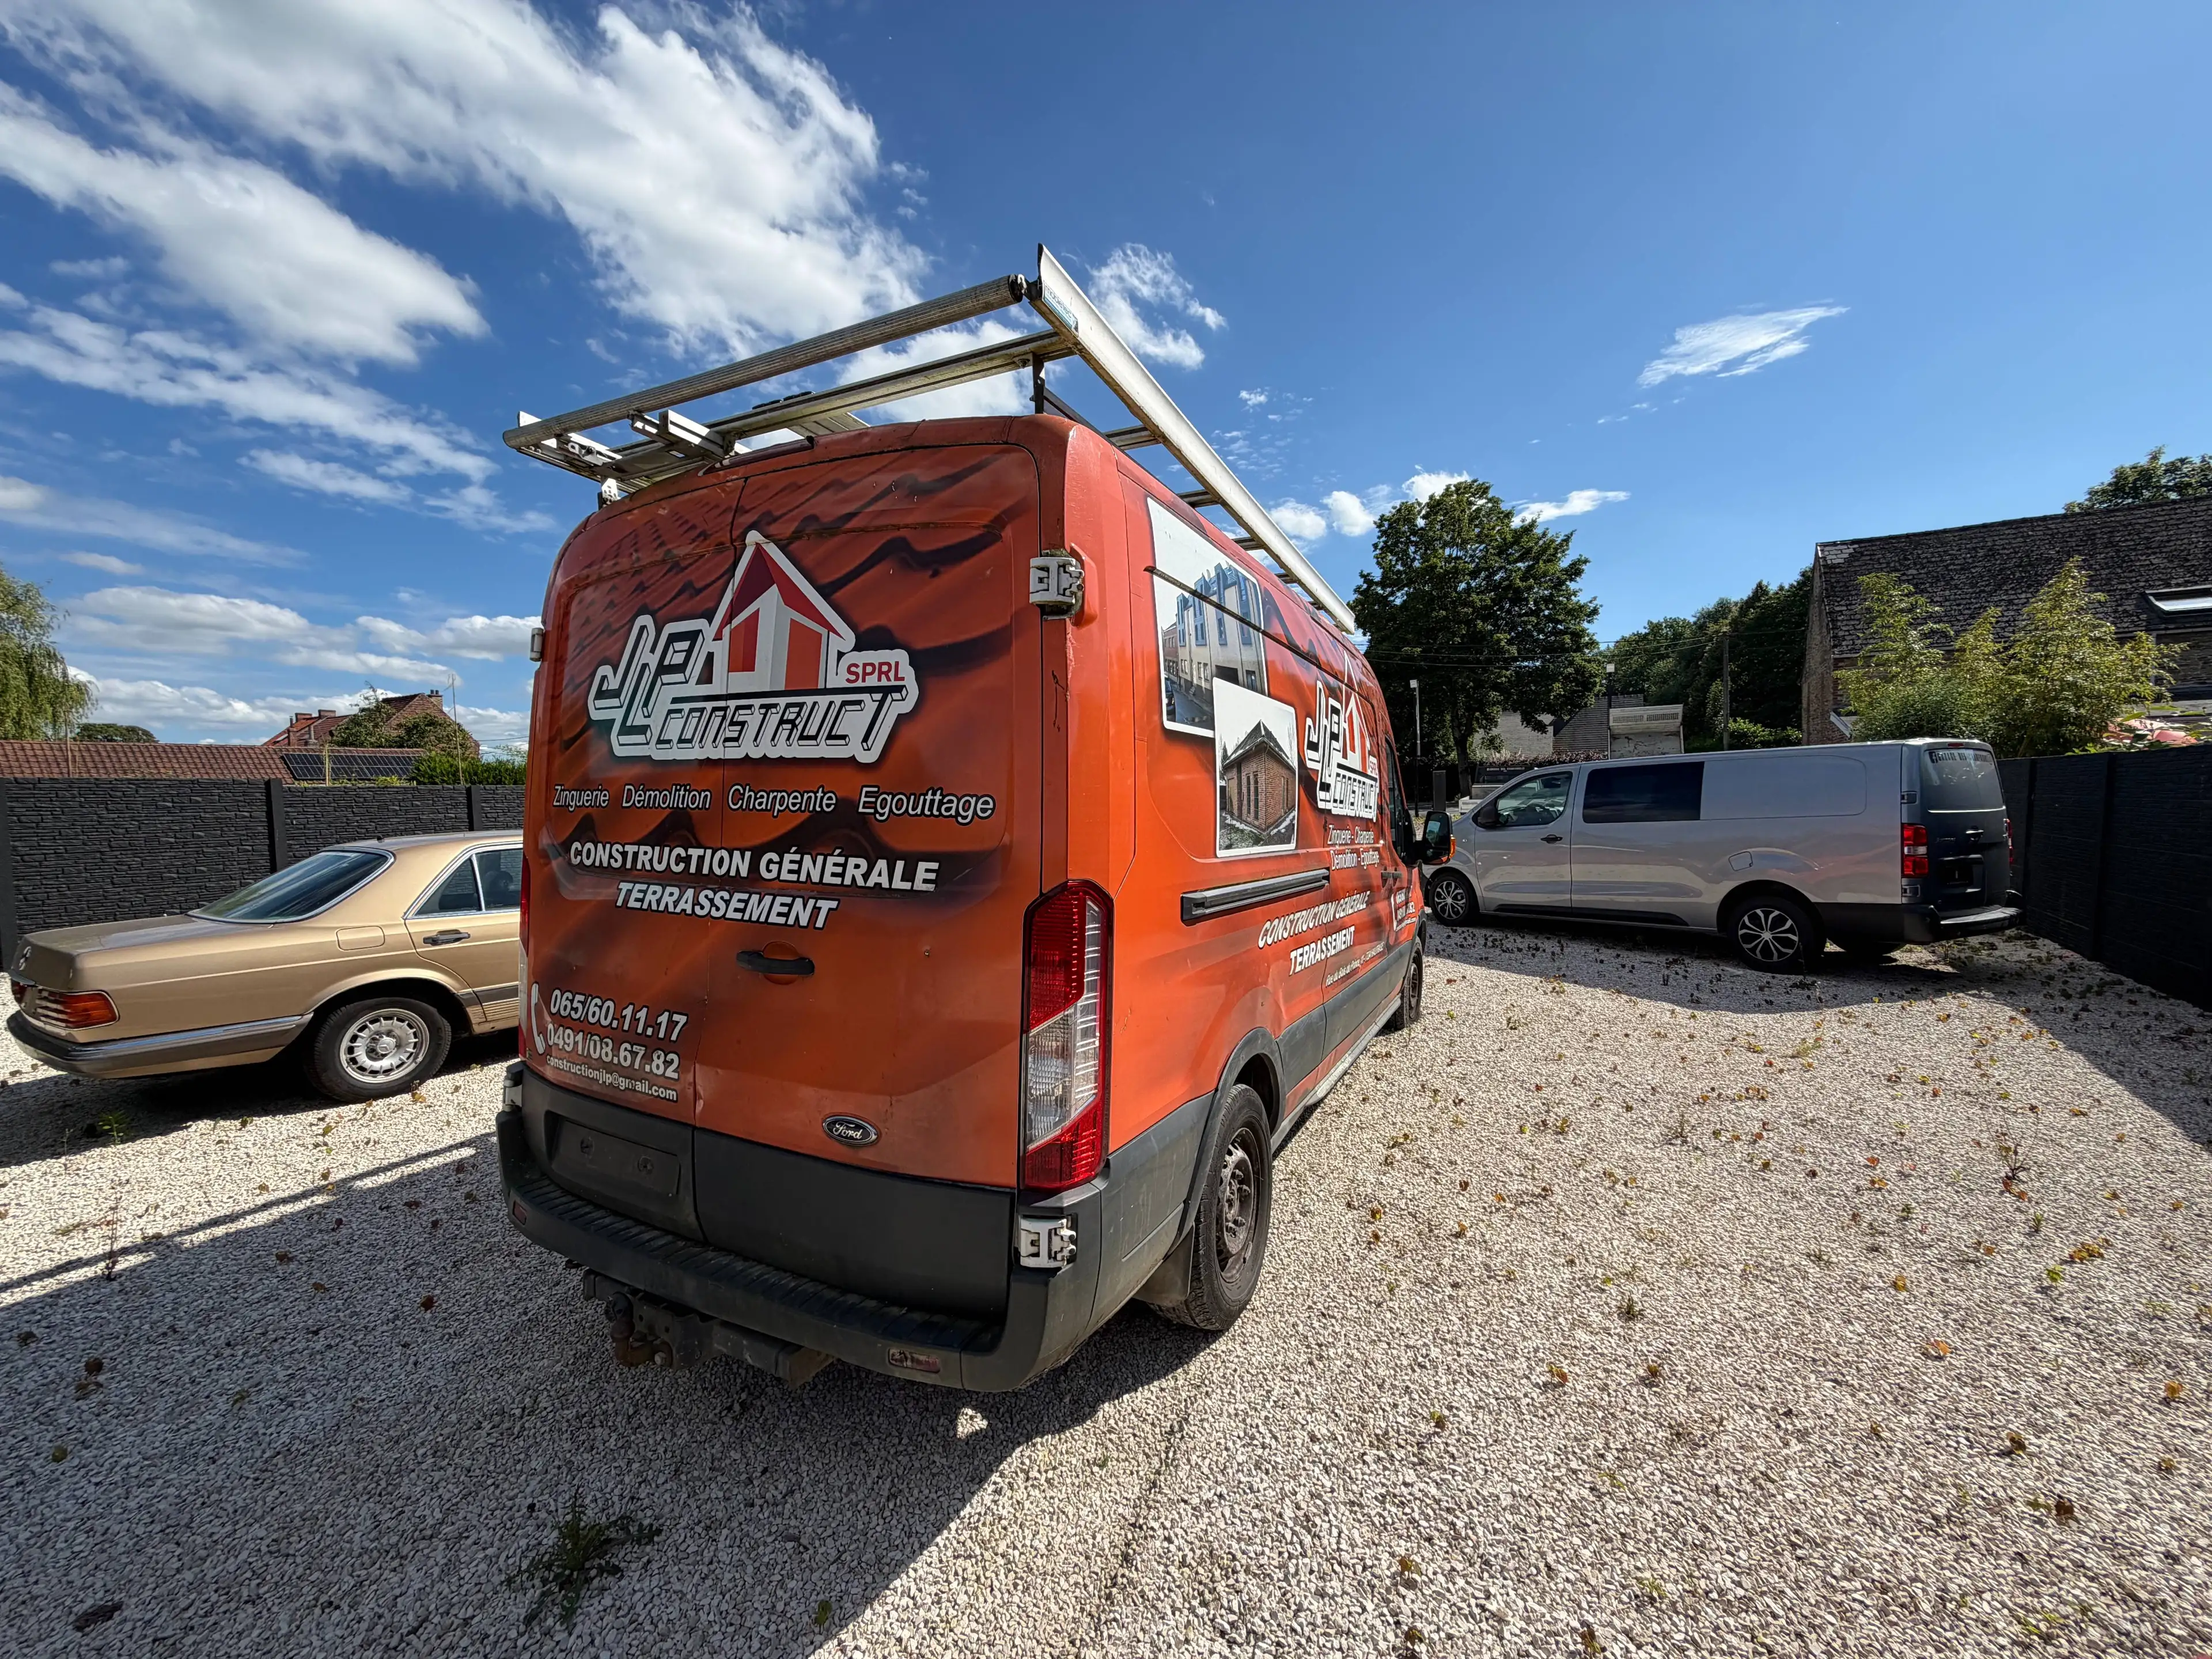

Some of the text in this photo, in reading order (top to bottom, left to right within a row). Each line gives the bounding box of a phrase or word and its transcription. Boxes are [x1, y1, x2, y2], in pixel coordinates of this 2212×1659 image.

[844, 662, 906, 685] SPRL
[655, 686, 908, 751] CONSTRUCT
[553, 785, 995, 823] Zinguerie Démolition Charpente Egouttage
[570, 841, 940, 892] CONSTRUCTION GÉNÉRALE
[615, 882, 838, 930] TERRASSEMENT
[1258, 900, 1338, 948] CONSTRUCTION
[1335, 891, 1370, 920] GÉNÉRALE
[1289, 926, 1355, 975] TERRASSEMENT
[550, 989, 688, 1041] 065/60.11.17
[547, 1023, 680, 1080] 0491/08.67.82
[546, 1054, 678, 1101] constructionjlp@gmail.com
[833, 1121, 863, 1140] Ford
